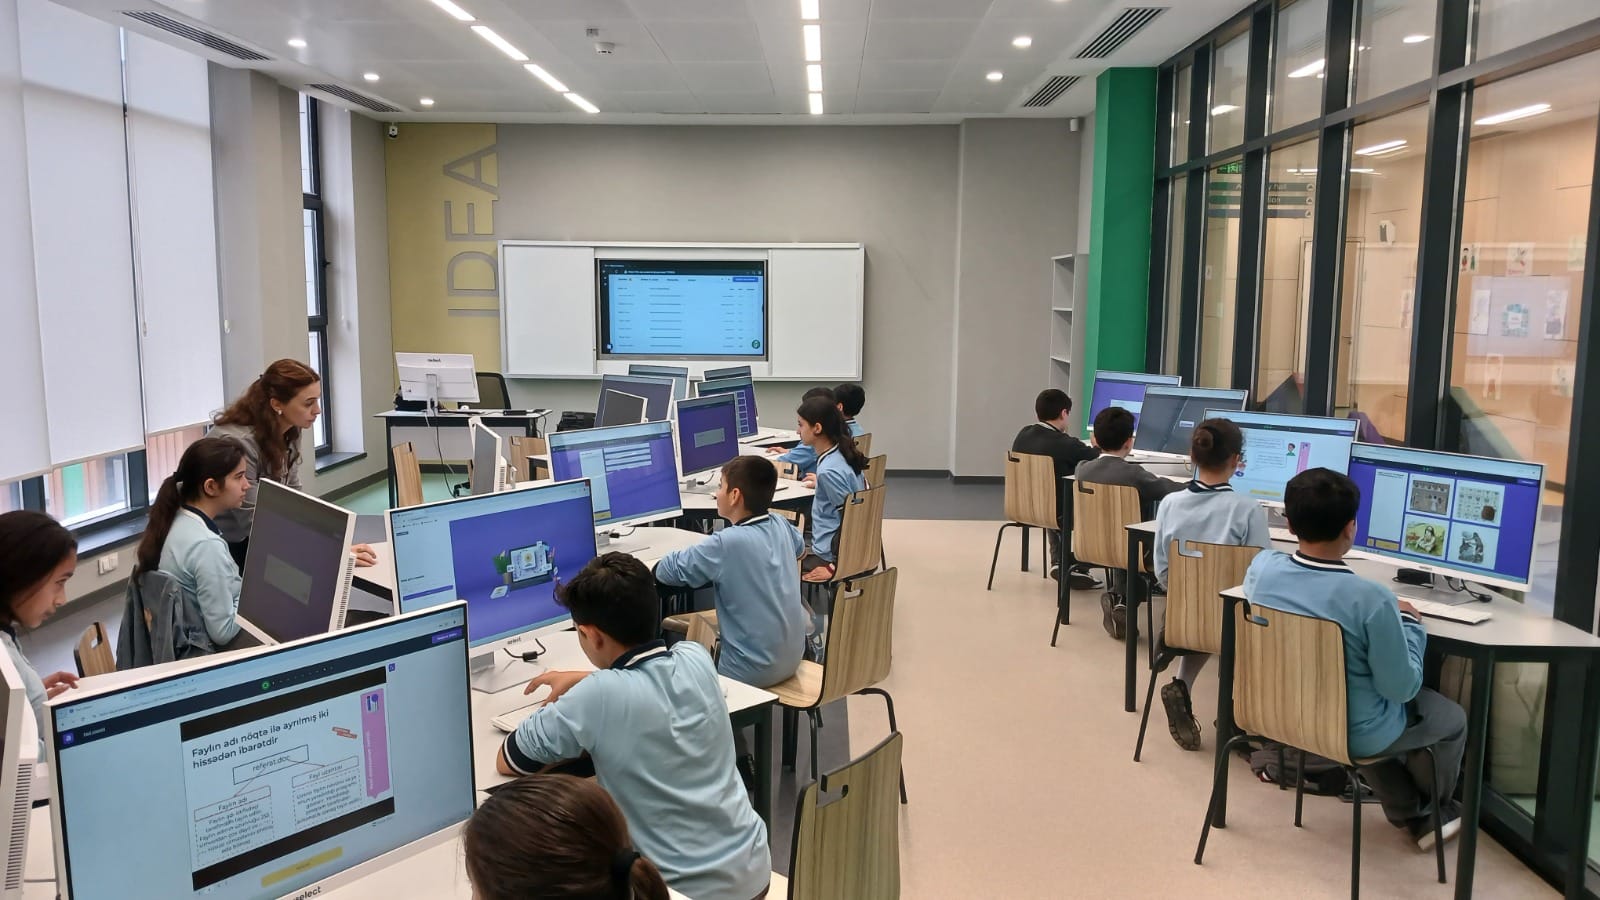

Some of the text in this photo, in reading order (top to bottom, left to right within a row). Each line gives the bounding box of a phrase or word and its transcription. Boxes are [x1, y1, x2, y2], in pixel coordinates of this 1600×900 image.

[442, 143, 500, 317] IDEA
[192, 710, 328, 758] Faylın adı nöqtə ilə ayrılmış iki
[193, 737, 278, 768] hissədən ibarətdir
